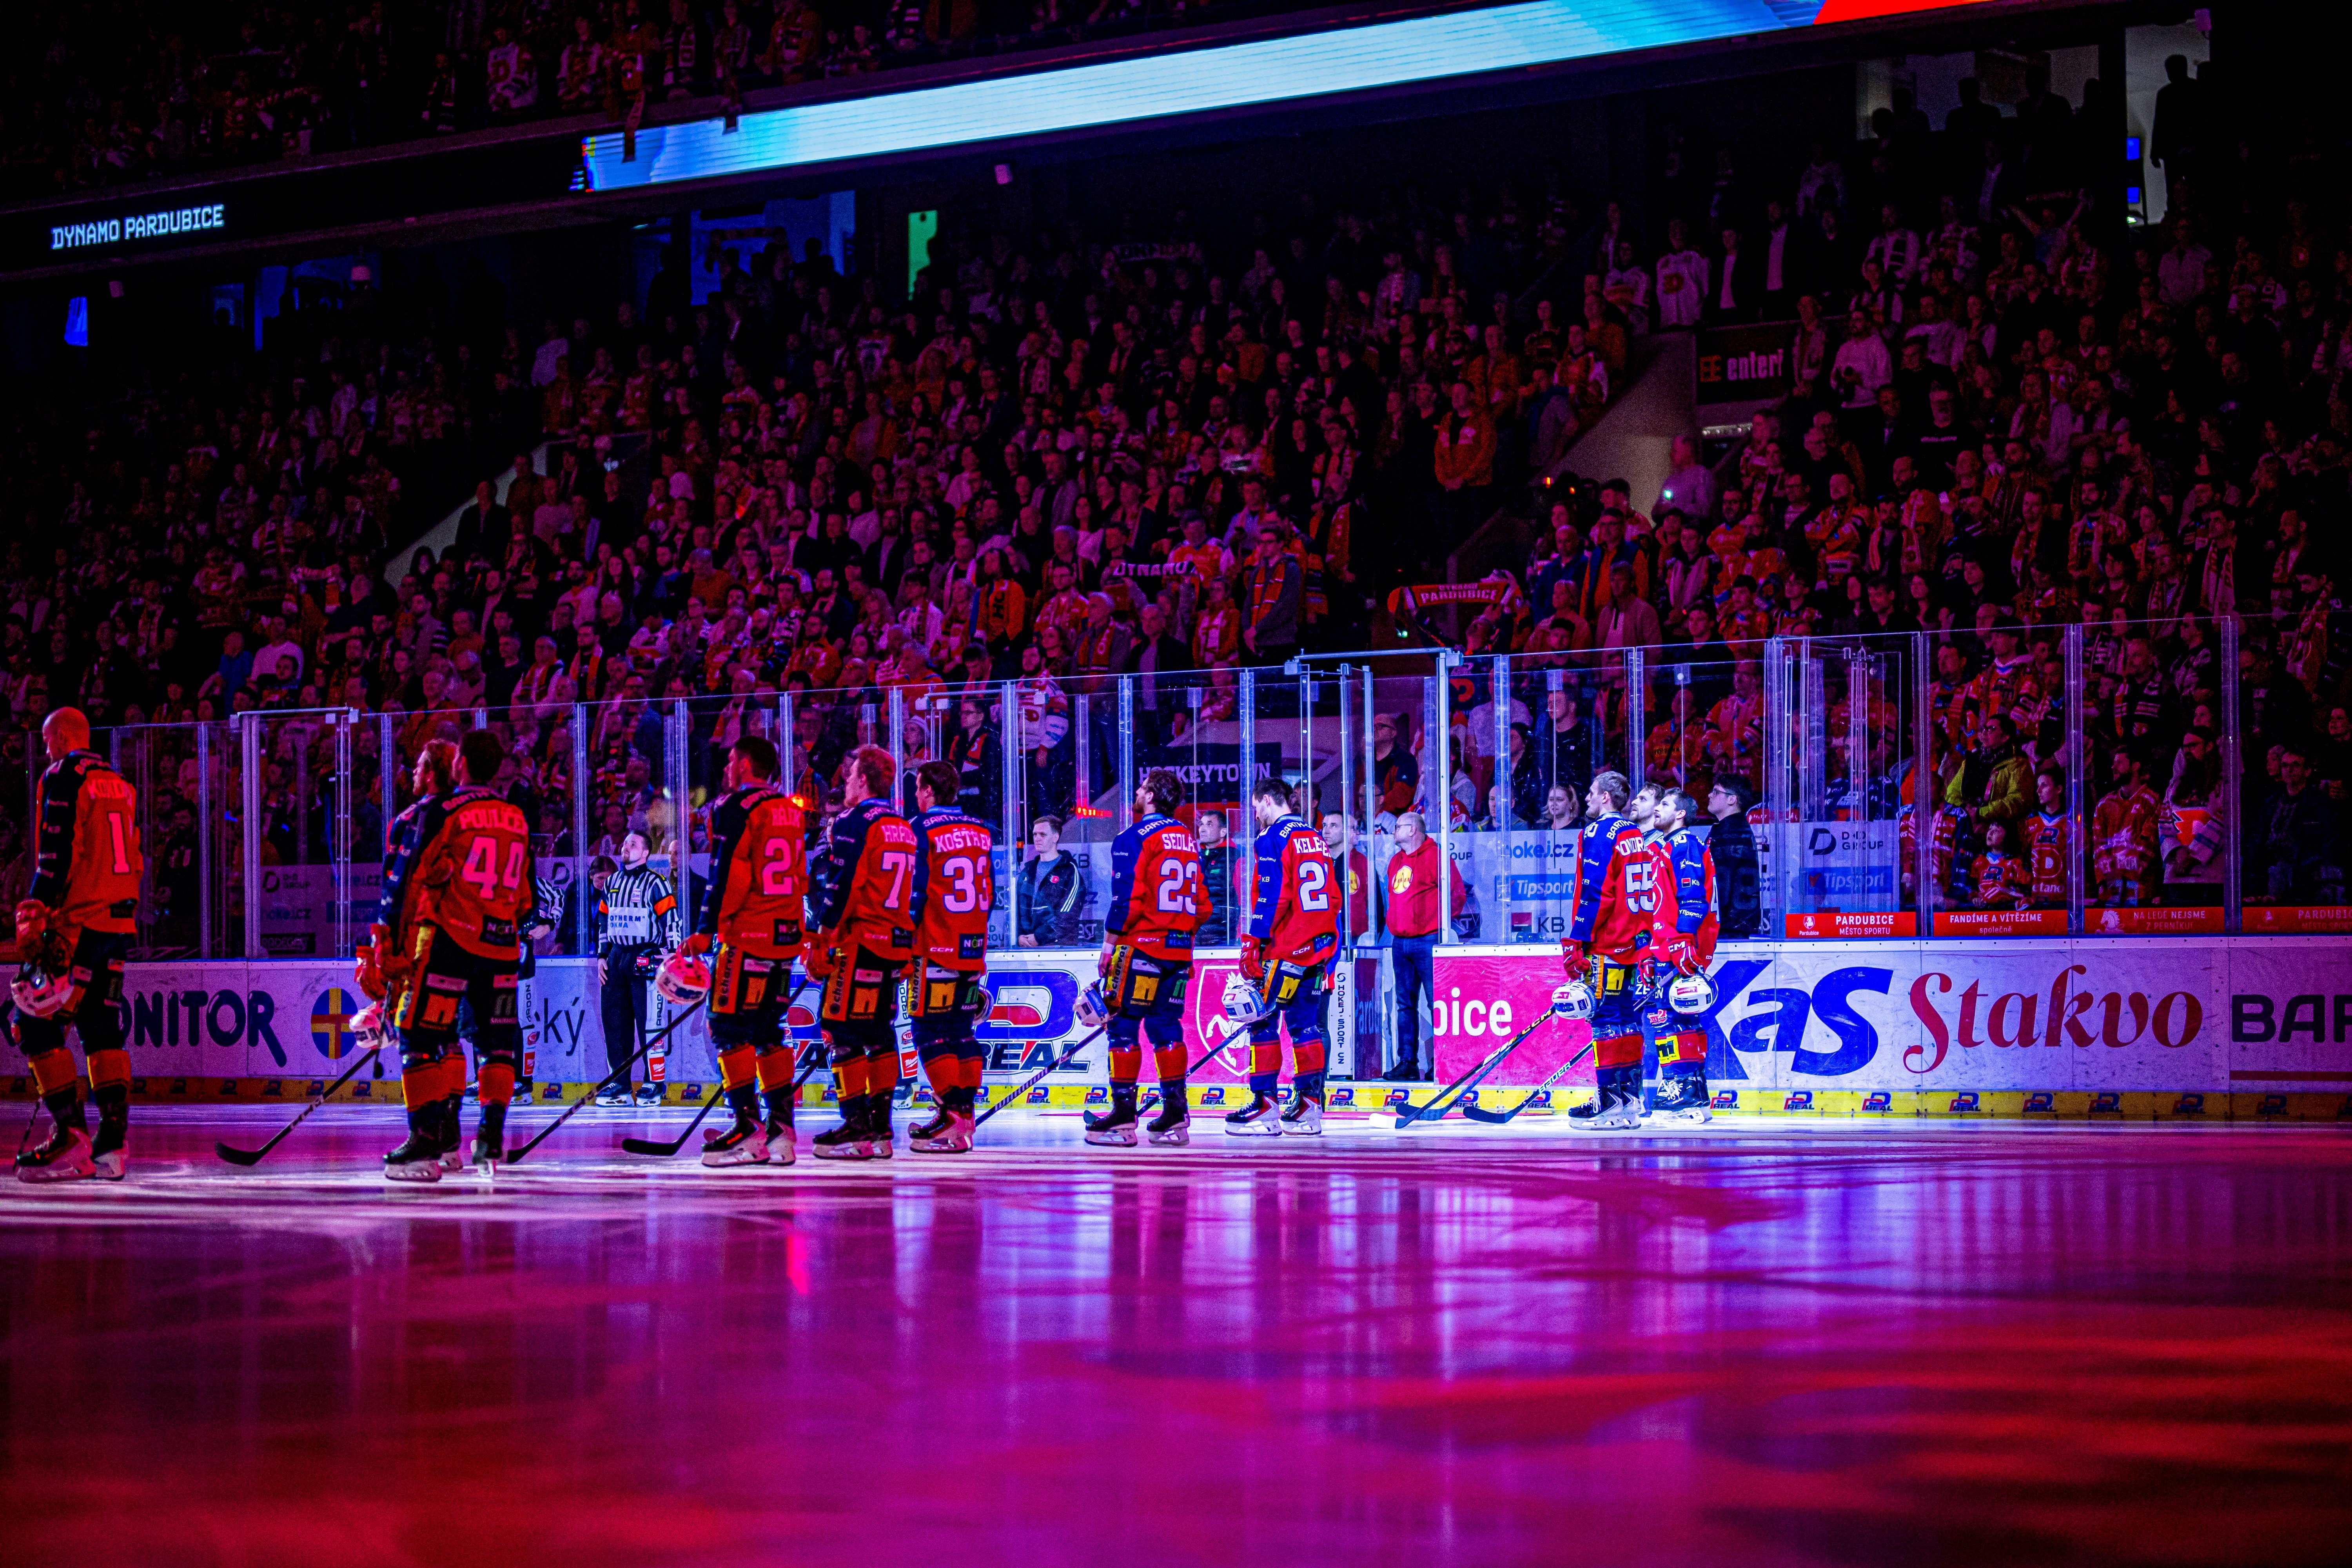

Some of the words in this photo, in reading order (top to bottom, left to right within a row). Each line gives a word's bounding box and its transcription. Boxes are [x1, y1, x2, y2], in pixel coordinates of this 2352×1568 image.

[52, 219, 120, 250] DYNAMO
[125, 204, 225, 240] PARDUBICE
[1139, 763, 1271, 784] HKEYTOWN
[1509, 840, 1574, 858] okej.cz
[1842, 840, 1884, 851] GROUP
[762, 837, 802, 895] 2
[1159, 859, 1198, 915] 23
[1299, 861, 1328, 911] 2
[1516, 878, 1573, 898] Tipsport
[1625, 862, 1654, 913] 55
[2031, 882, 2065, 893] etano
[1682, 909, 1703, 918] Tipsport
[1835, 915, 1894, 926] PARDUBICE
[1949, 914, 1989, 923] FANDÍME
[2000, 912, 2042, 922] VÍTĚZÍME
[2134, 911, 2146, 920] NA
[2171, 910, 2206, 919] NEJSME
[1537, 916, 1565, 933] KB
[1839, 926, 1862, 935] MĚSTO
[2146, 922, 2151, 930] Z
[2329, 922, 2352, 930] SPORT
[1292, 945, 1311, 956] CCM
[1668, 941, 1686, 953] CM
[1522, 1009, 1553, 1035] CCM
[1903, 964, 2203, 1074] Stakvo
